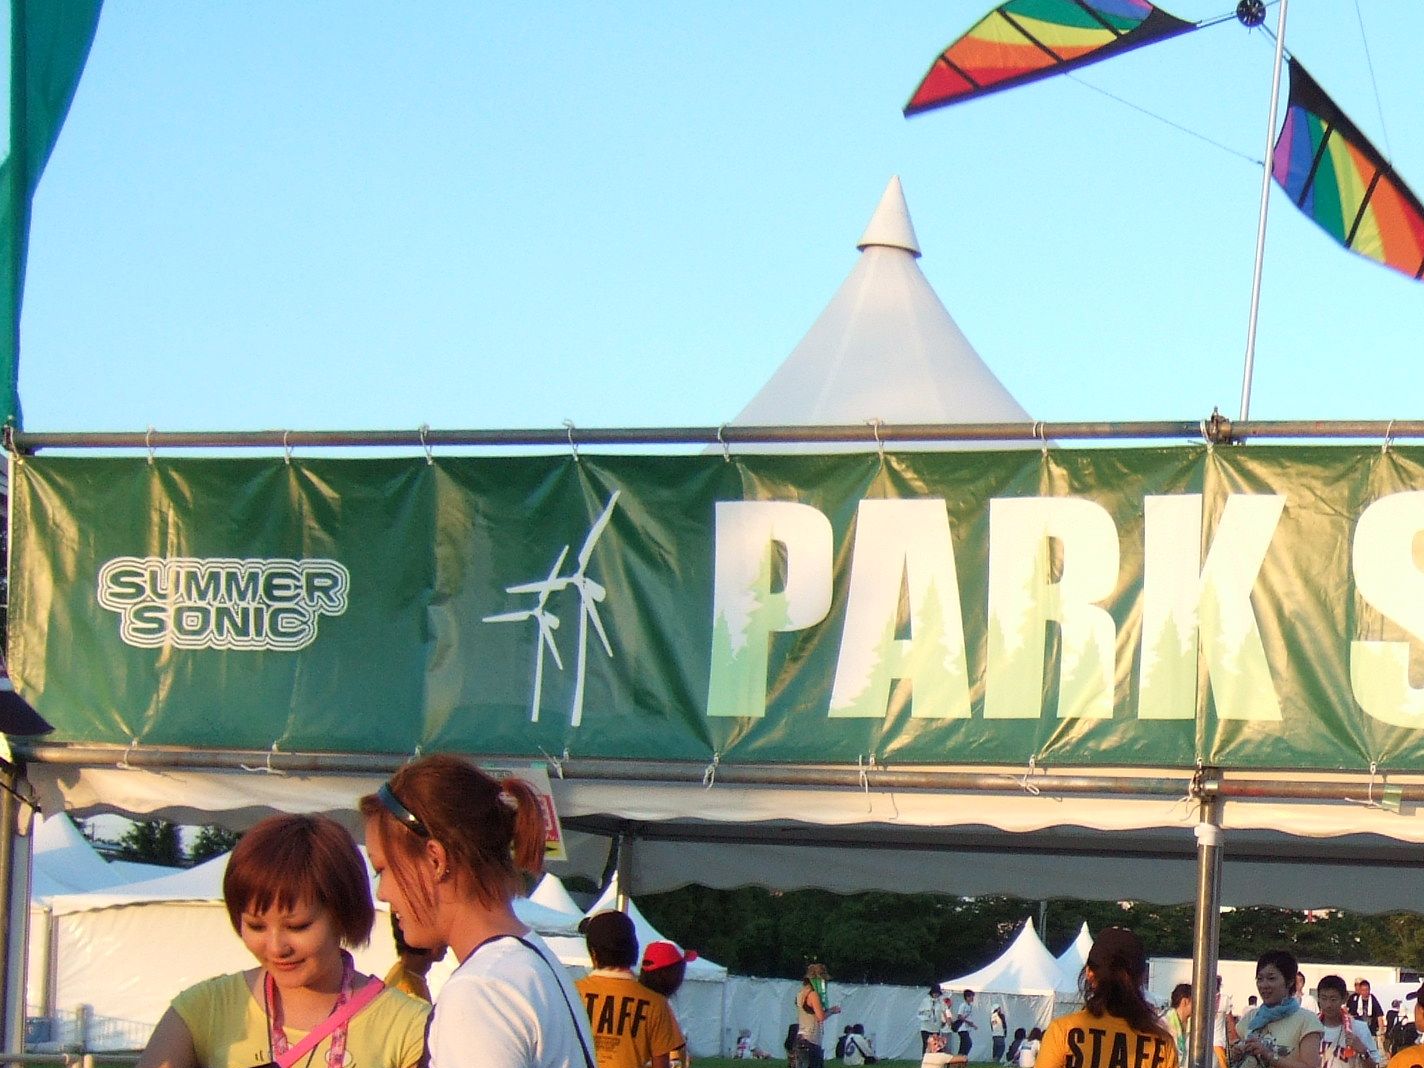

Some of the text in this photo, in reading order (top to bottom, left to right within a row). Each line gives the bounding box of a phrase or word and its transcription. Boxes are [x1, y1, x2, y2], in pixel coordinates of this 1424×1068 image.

[101, 561, 346, 607] SUMMER
[124, 602, 313, 645] SONIC
[706, 494, 1287, 721] PARK
[584, 992, 650, 1038] TAFF
